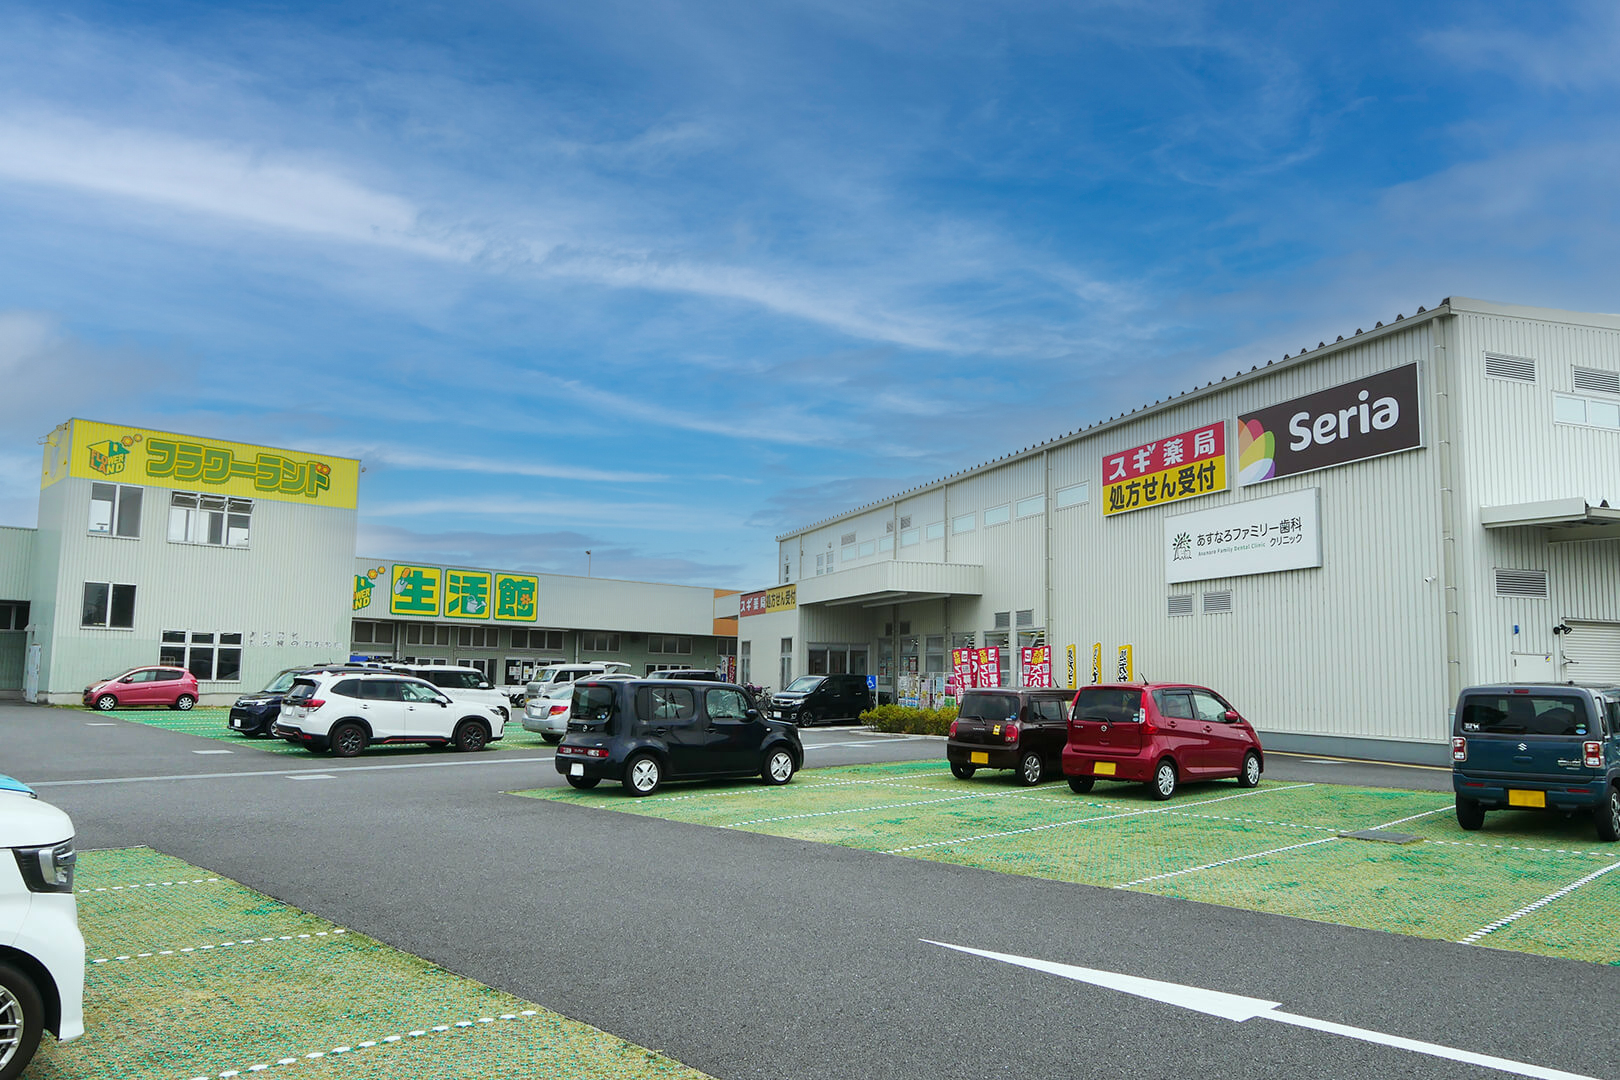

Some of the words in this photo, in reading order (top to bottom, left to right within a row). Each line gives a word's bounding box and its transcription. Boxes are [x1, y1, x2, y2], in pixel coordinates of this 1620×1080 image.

[1288, 389, 1400, 452] Seria
[146, 438, 331, 498] フラワーランド
[1109, 429, 1216, 481] スギ薬局
[1109, 460, 1216, 512] 処方せん受付
[1196, 516, 1303, 547] あすなろファミリー歯科
[1234, 544, 1251, 552] Dental
[1269, 533, 1303, 548] クリニック
[395, 570, 536, 617] 生活館
